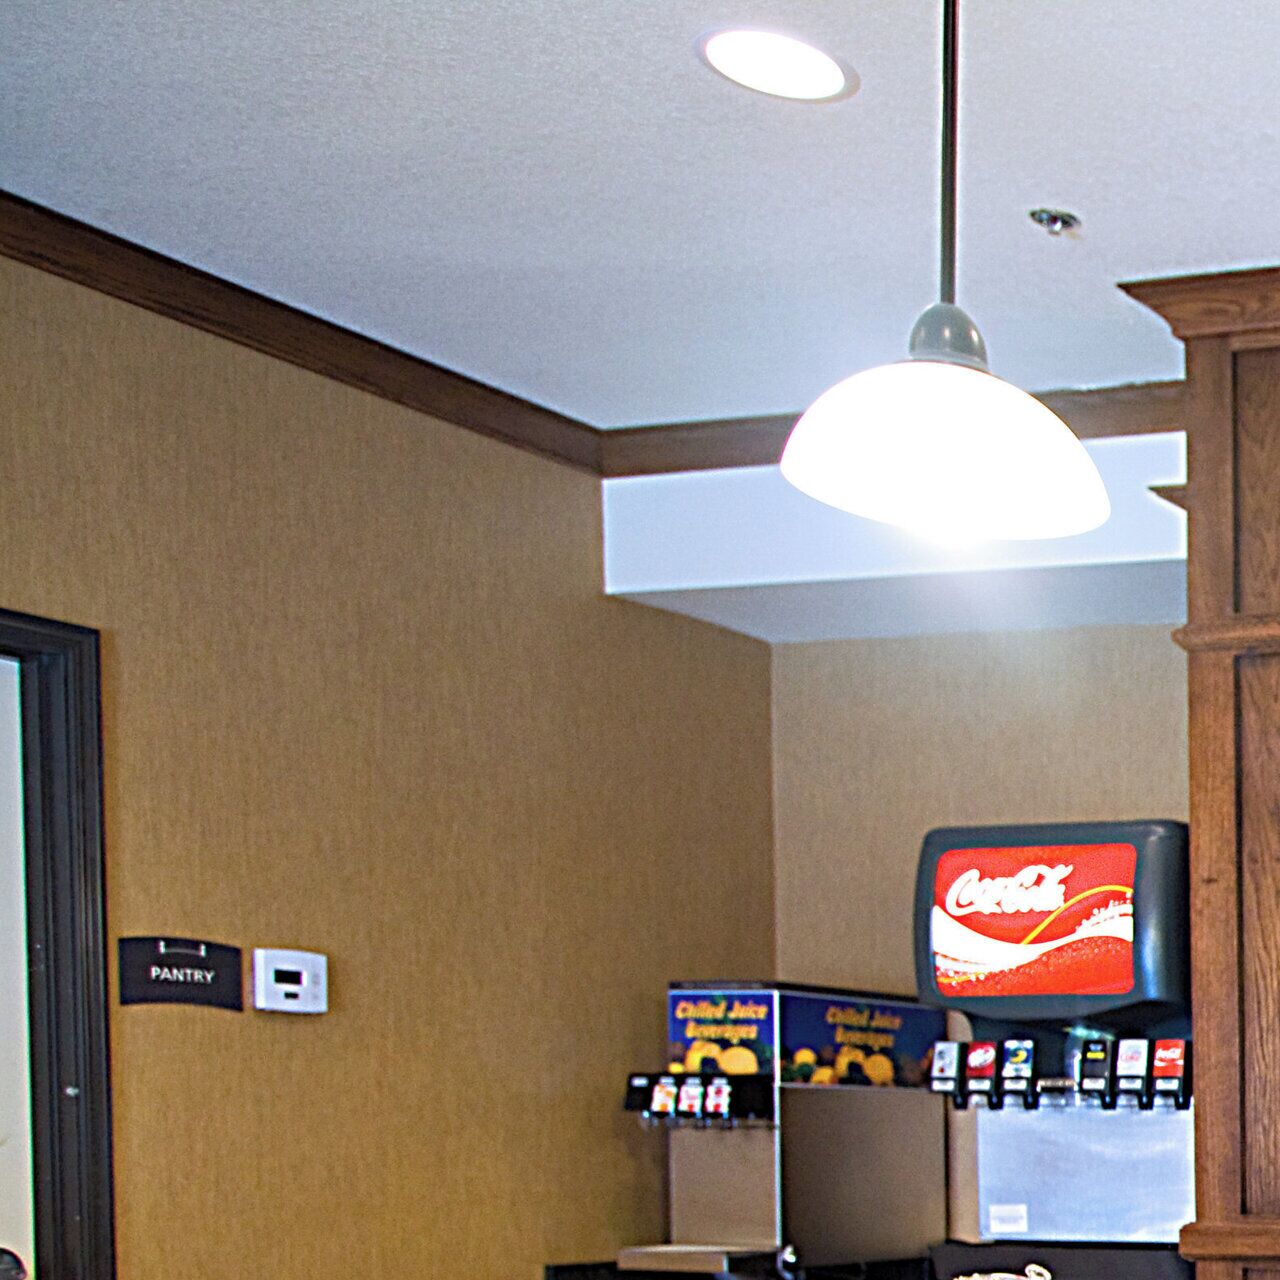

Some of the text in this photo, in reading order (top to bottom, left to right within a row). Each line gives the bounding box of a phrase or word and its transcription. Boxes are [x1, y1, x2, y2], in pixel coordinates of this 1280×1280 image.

[150, 964, 216, 984] PANTRY
[675, 1000, 768, 1019] Chilled Juice
[685, 1019, 758, 1044] Beverages
